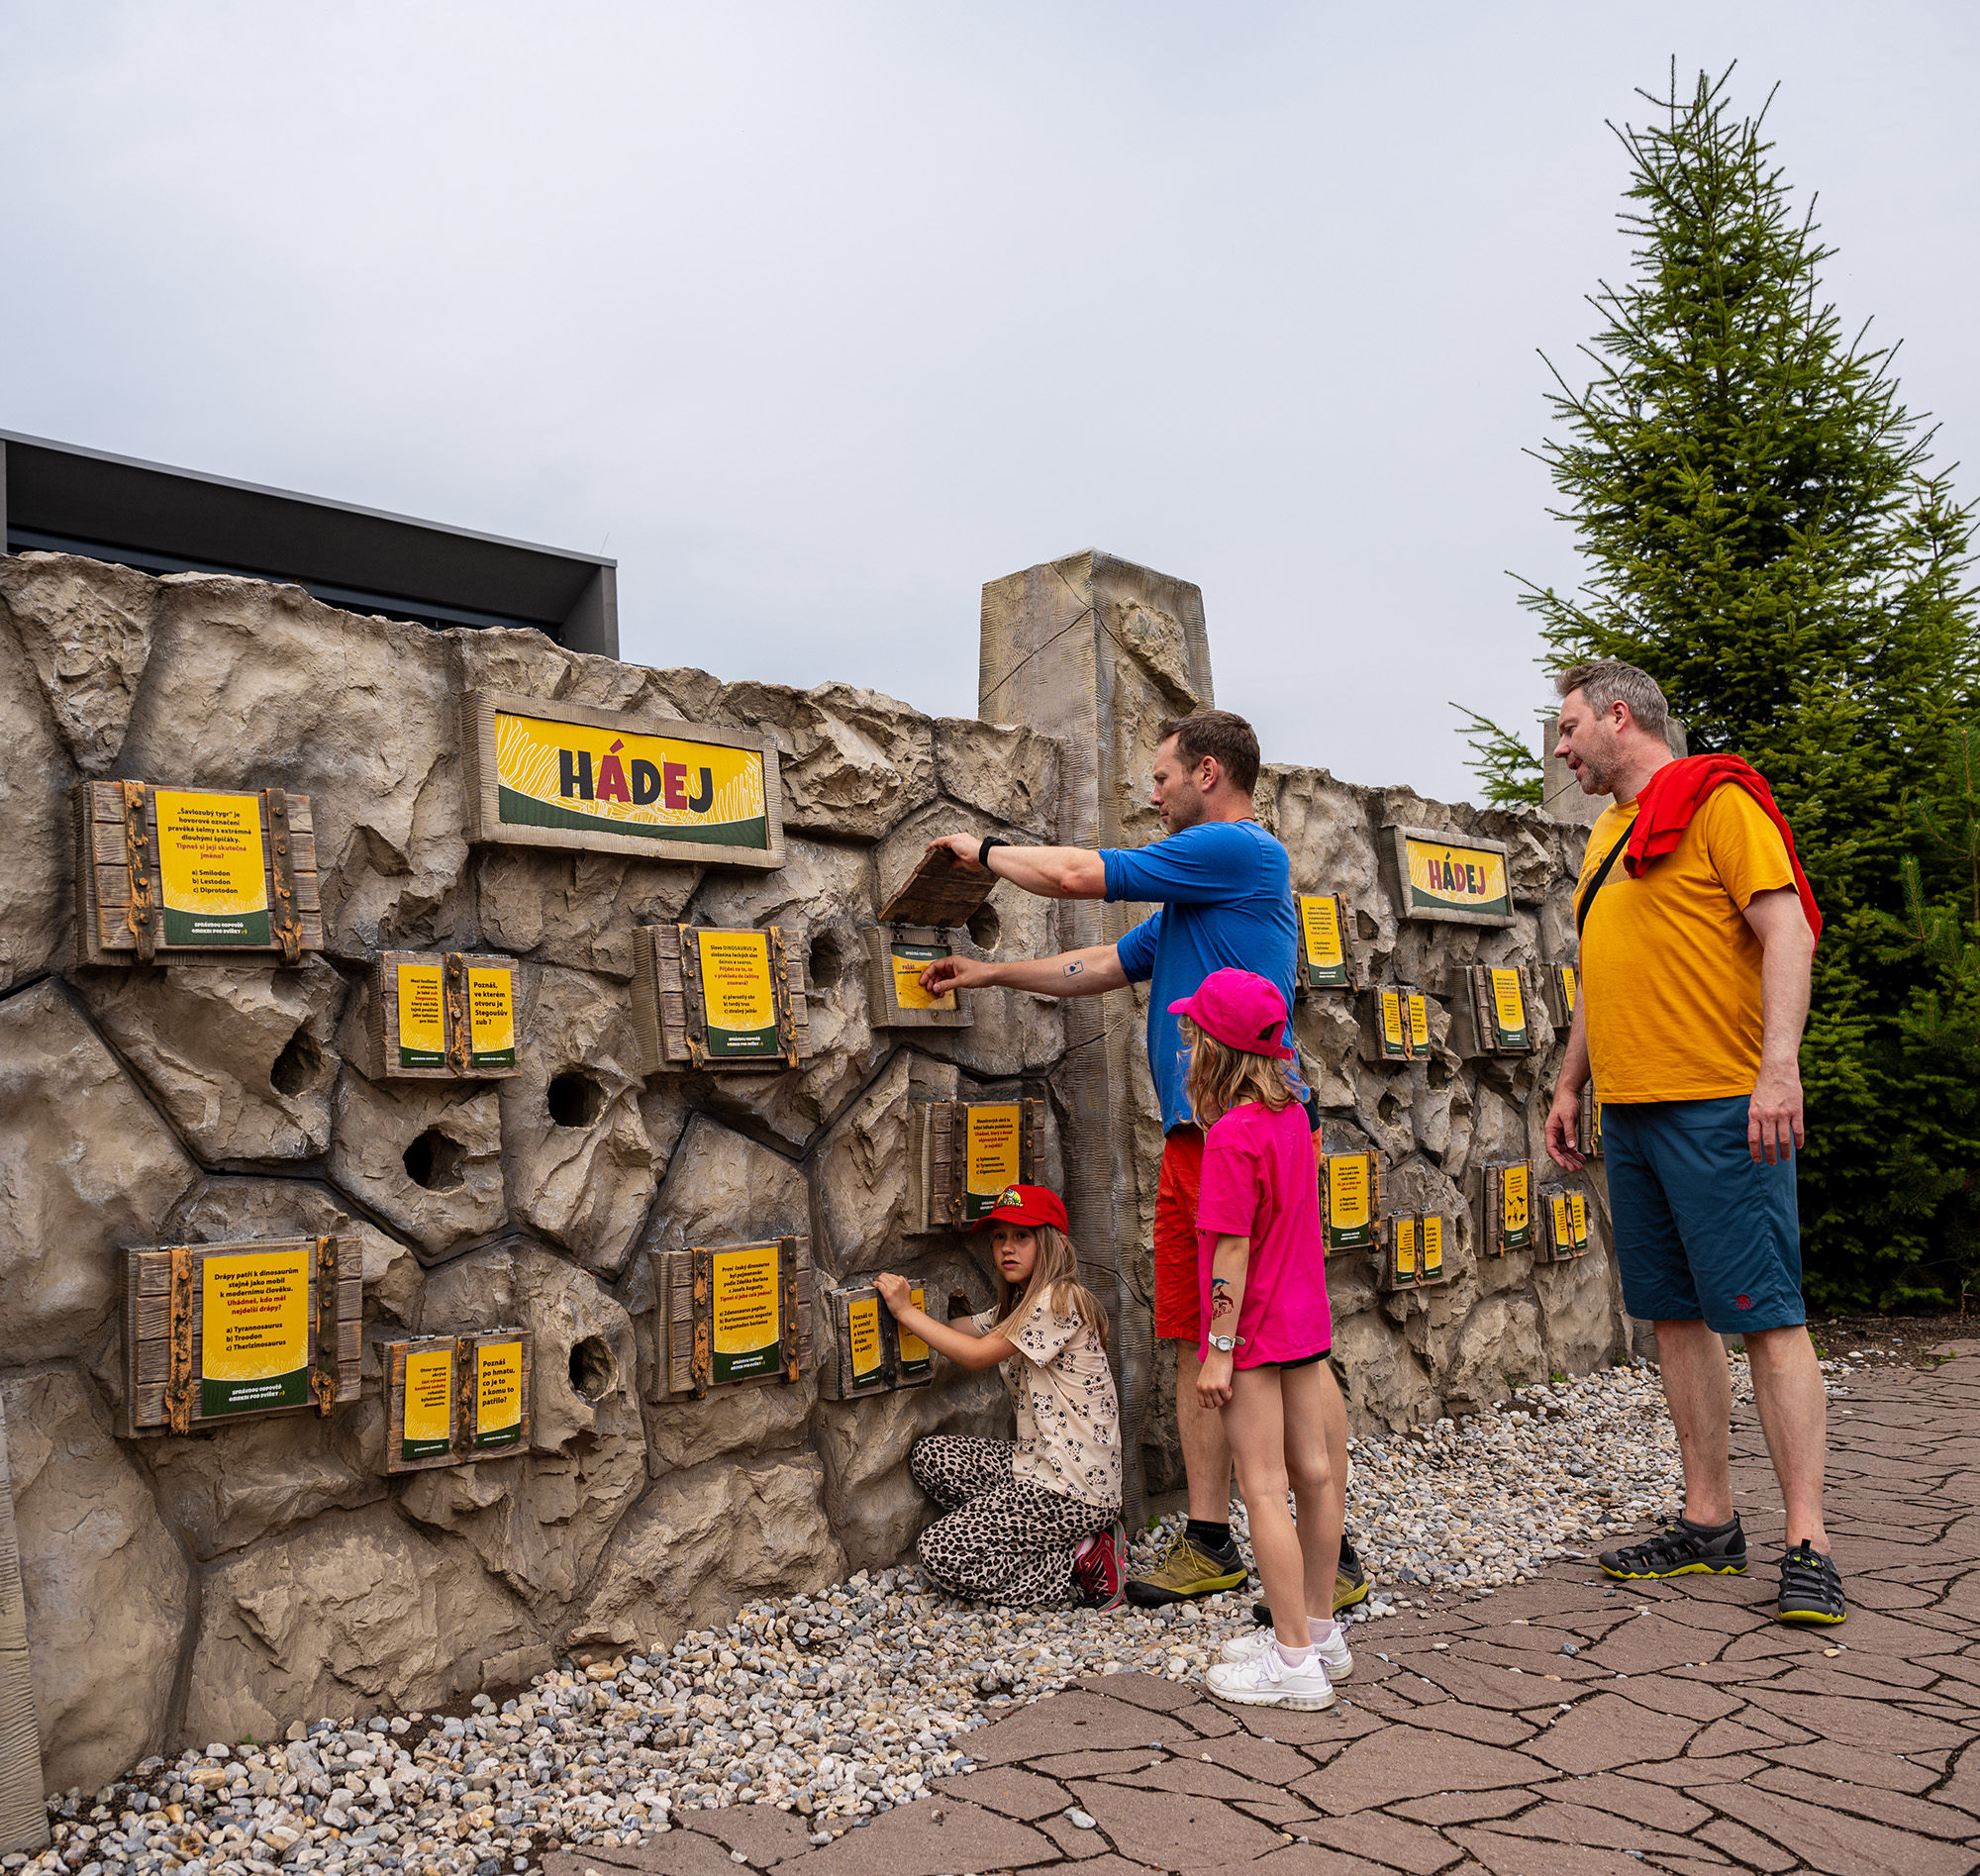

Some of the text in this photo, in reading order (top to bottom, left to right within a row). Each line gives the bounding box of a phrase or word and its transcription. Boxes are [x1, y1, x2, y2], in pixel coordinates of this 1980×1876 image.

[559, 738, 713, 813] HÁDEJ
[1428, 851, 1486, 895] HÁDEJ
[215, 1273, 235, 1281] Drápy
[260, 1268, 298, 1277] dinosaurům
[229, 1280, 249, 1288] stejně
[250, 1279, 264, 1287] jako
[226, 1289, 264, 1297] modernímu
[227, 1298, 258, 1307] Uhádneš,
[232, 1304, 282, 1316] nejdelší drápy?
[234, 1323, 282, 1332] Tyrannosaurus
[233, 1340, 286, 1350] Therizinosaurus
[483, 1359, 506, 1367] Poznáš
[482, 1397, 507, 1406] patřilo?
